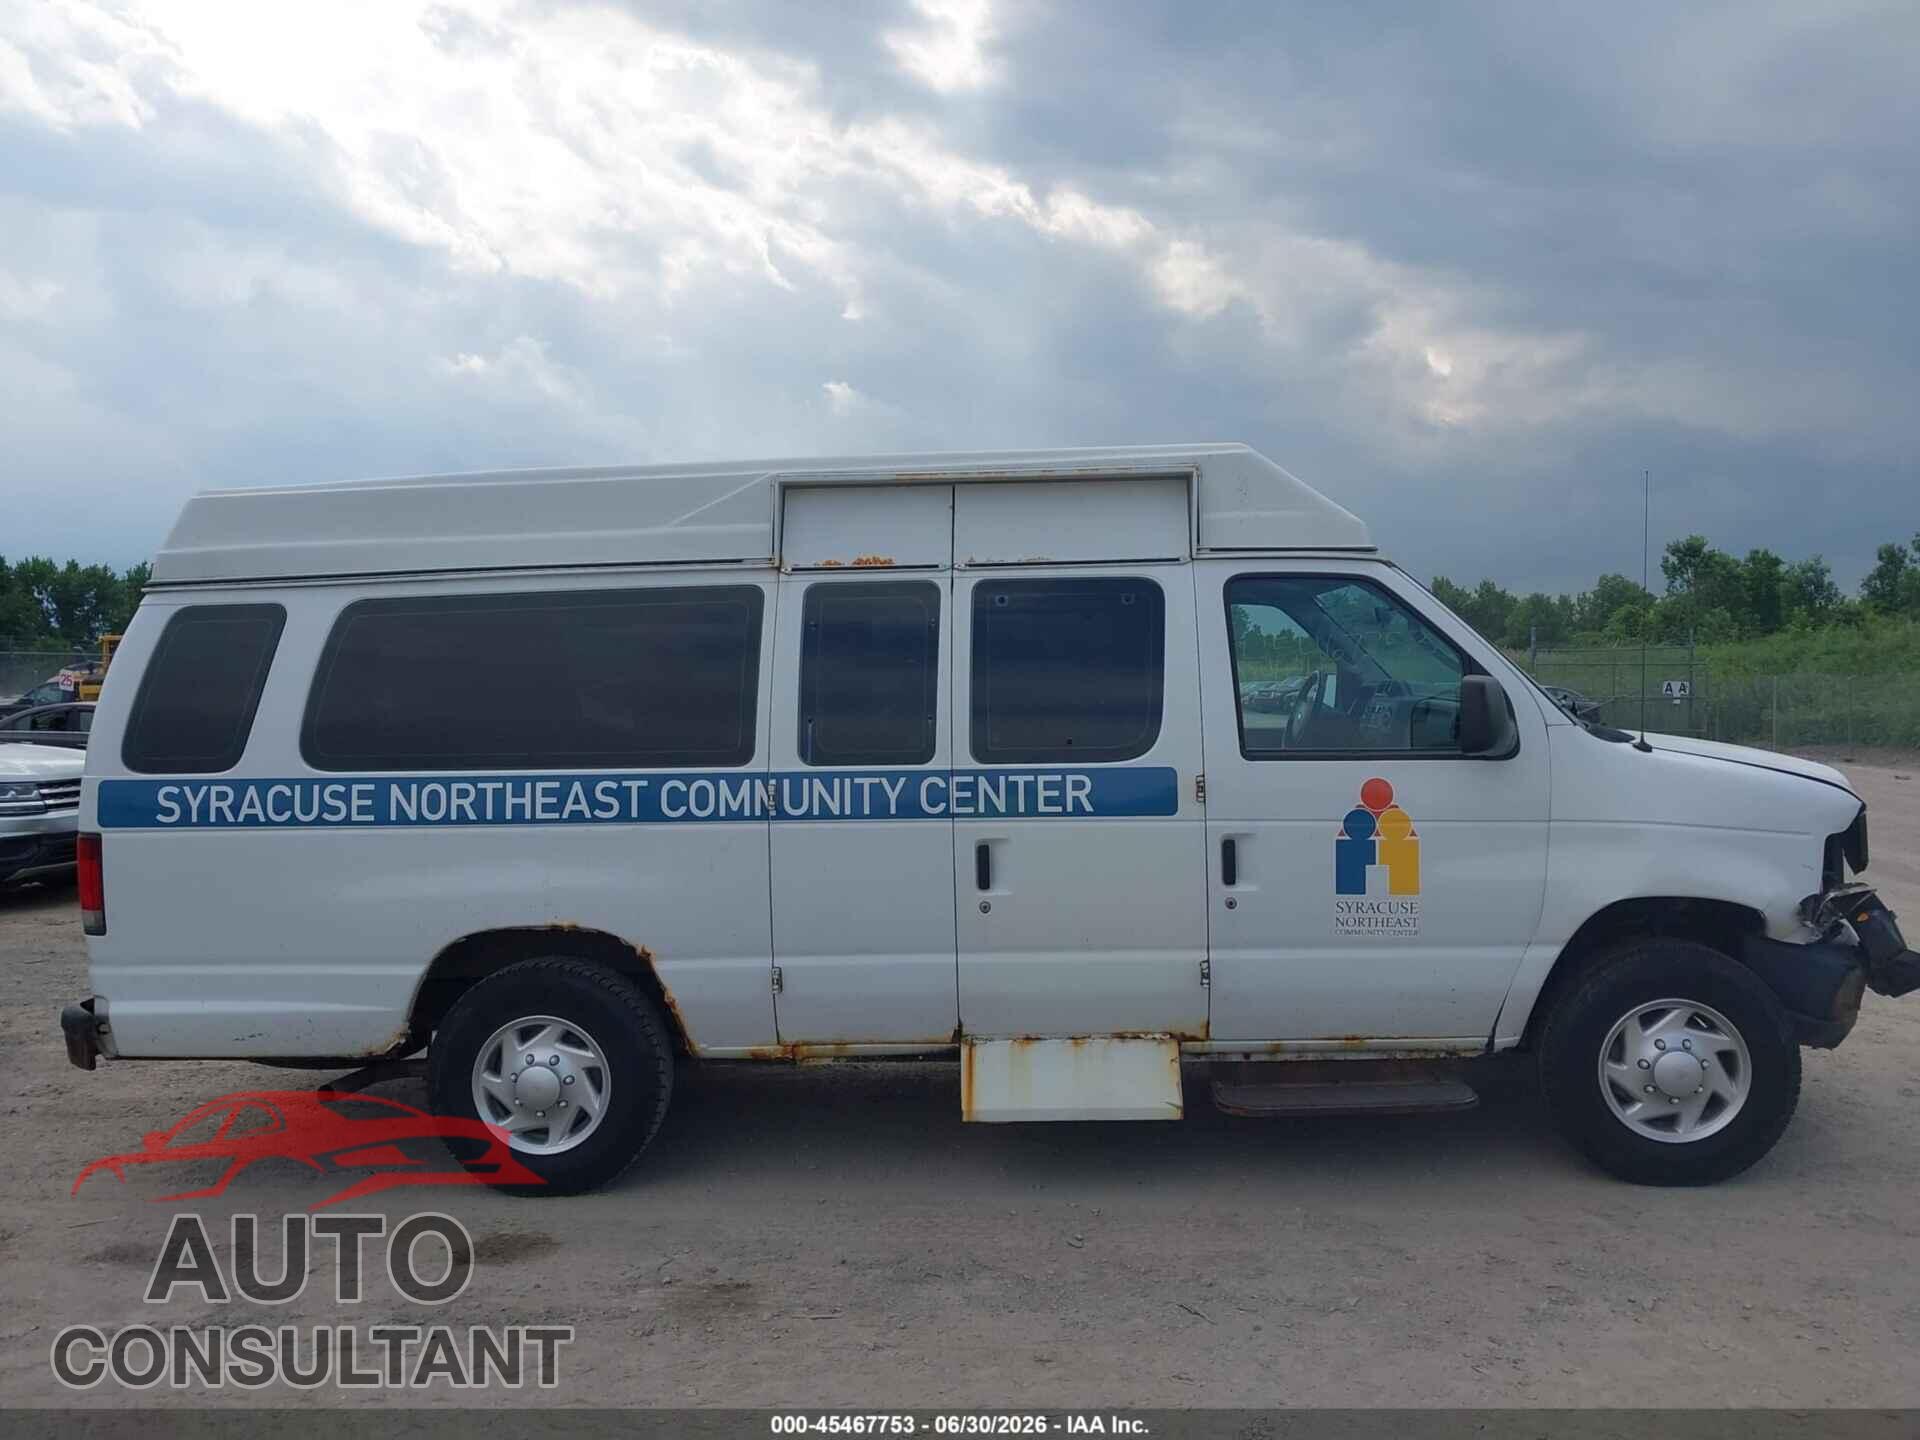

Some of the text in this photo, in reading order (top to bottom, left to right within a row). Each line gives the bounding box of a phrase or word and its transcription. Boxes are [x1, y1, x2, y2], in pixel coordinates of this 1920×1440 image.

[156, 774, 1094, 823] SYRACUSE NORTHEAST COMMUNITY CENTER
[1335, 901, 1419, 914] SYRACUSE
[1335, 916, 1418, 928] NORTHEAST
